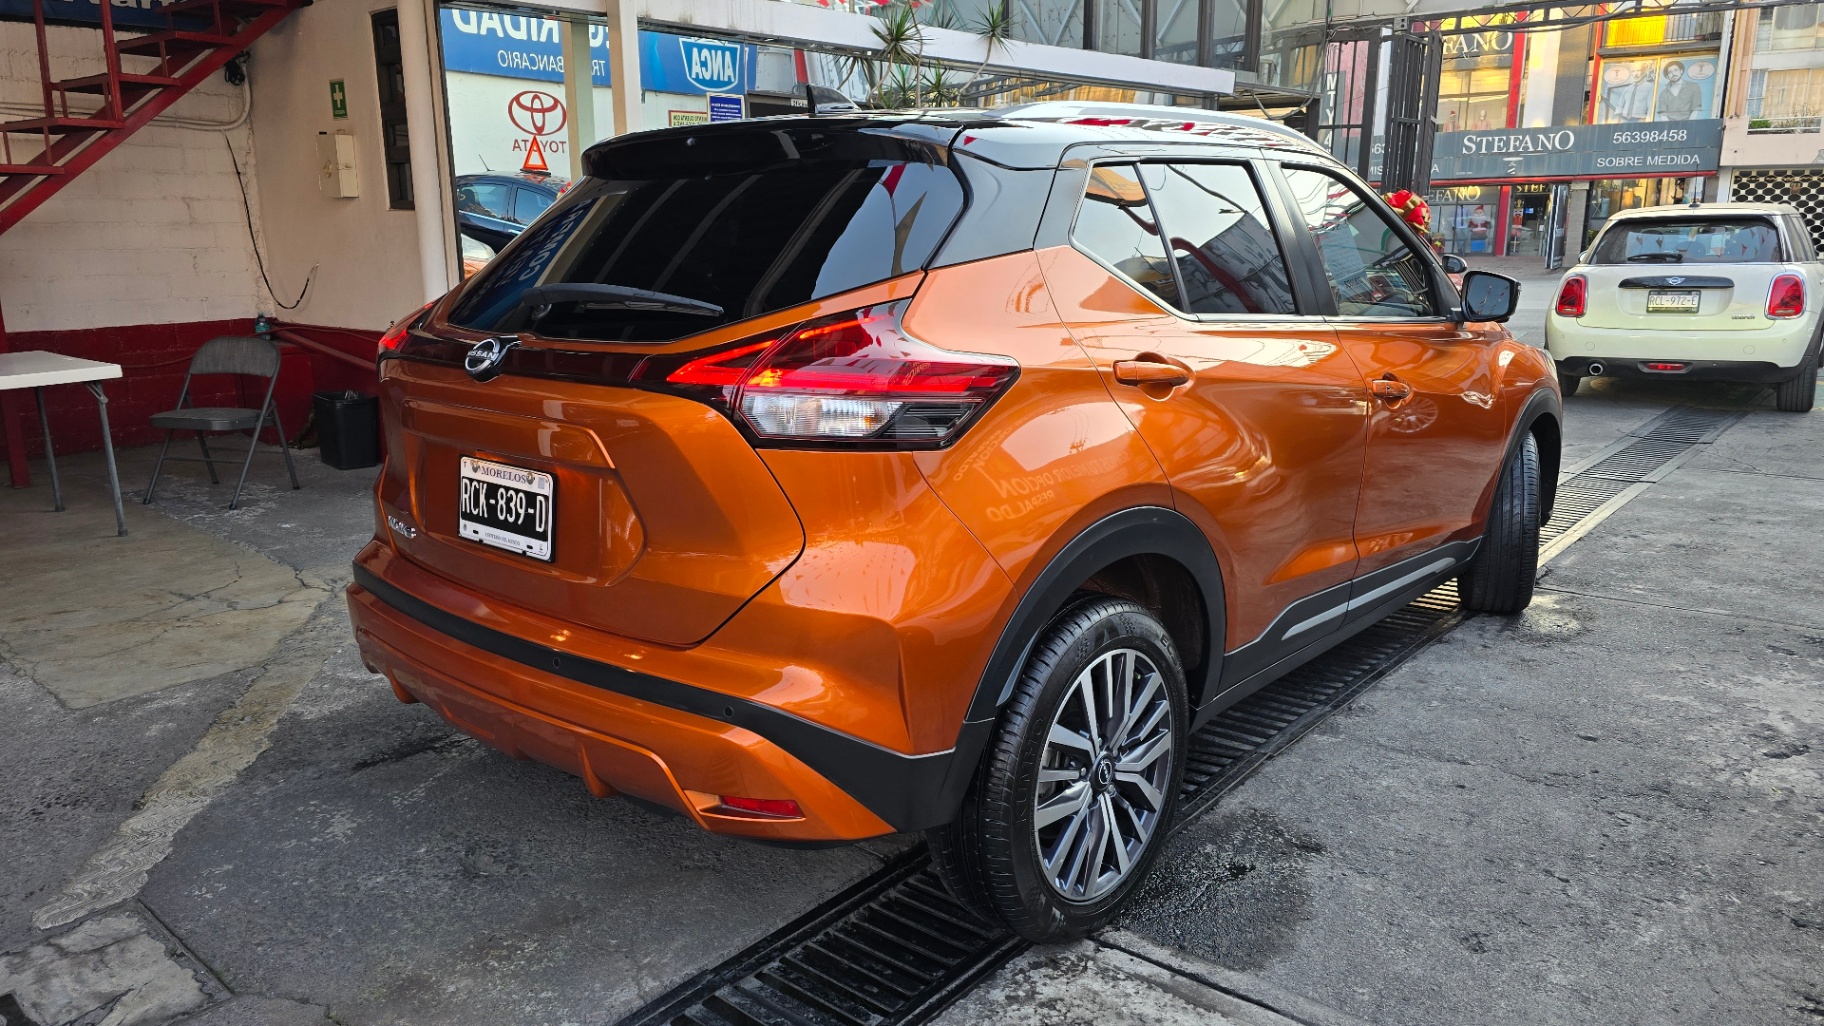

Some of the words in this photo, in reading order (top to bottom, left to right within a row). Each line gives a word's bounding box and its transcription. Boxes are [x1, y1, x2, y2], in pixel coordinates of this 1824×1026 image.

[1462, 130, 1575, 155] STEFANO
[1613, 129, 1687, 144] 56398458
[1596, 156, 1643, 167] SOBRE
[1646, 154, 1700, 166] MEDIDA
[1649, 296, 1697, 306] RCL-972-E
[481, 466, 527, 484] MORELOS
[462, 478, 546, 533] RCK-839-D
